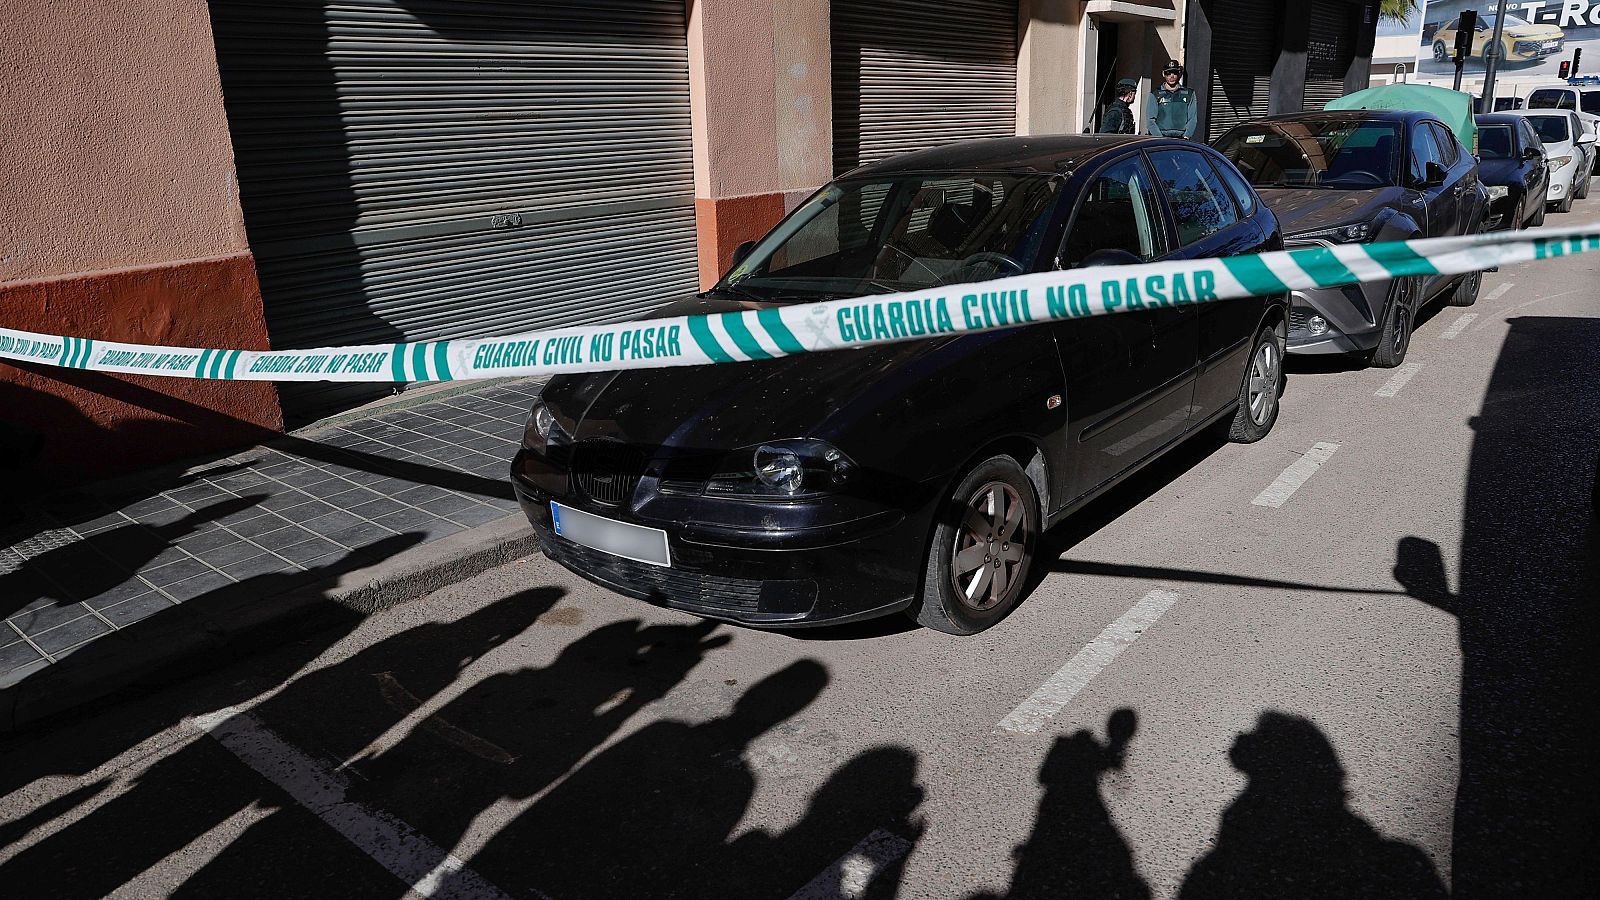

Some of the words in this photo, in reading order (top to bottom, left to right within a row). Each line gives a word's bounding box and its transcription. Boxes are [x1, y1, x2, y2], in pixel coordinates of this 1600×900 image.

[836, 297, 956, 342] GUARDIA
[960, 289, 1038, 330] CIVIL
[1046, 283, 1092, 318] NO
[1101, 269, 1217, 312] PASAR
[98, 350, 137, 366] GUARDIA
[130, 353, 152, 368] CIVIL
[150, 354, 171, 369] NO
[162, 354, 198, 370] PASAR
[249, 355, 300, 373] GUARDIA
[294, 354, 329, 373] CIVIL
[323, 354, 348, 374] NO
[342, 352, 389, 374] PASAR
[473, 339, 540, 369] GUARDIA
[542, 335, 584, 365] CIVIL
[589, 332, 615, 363] NO
[619, 325, 682, 361] PASAR
